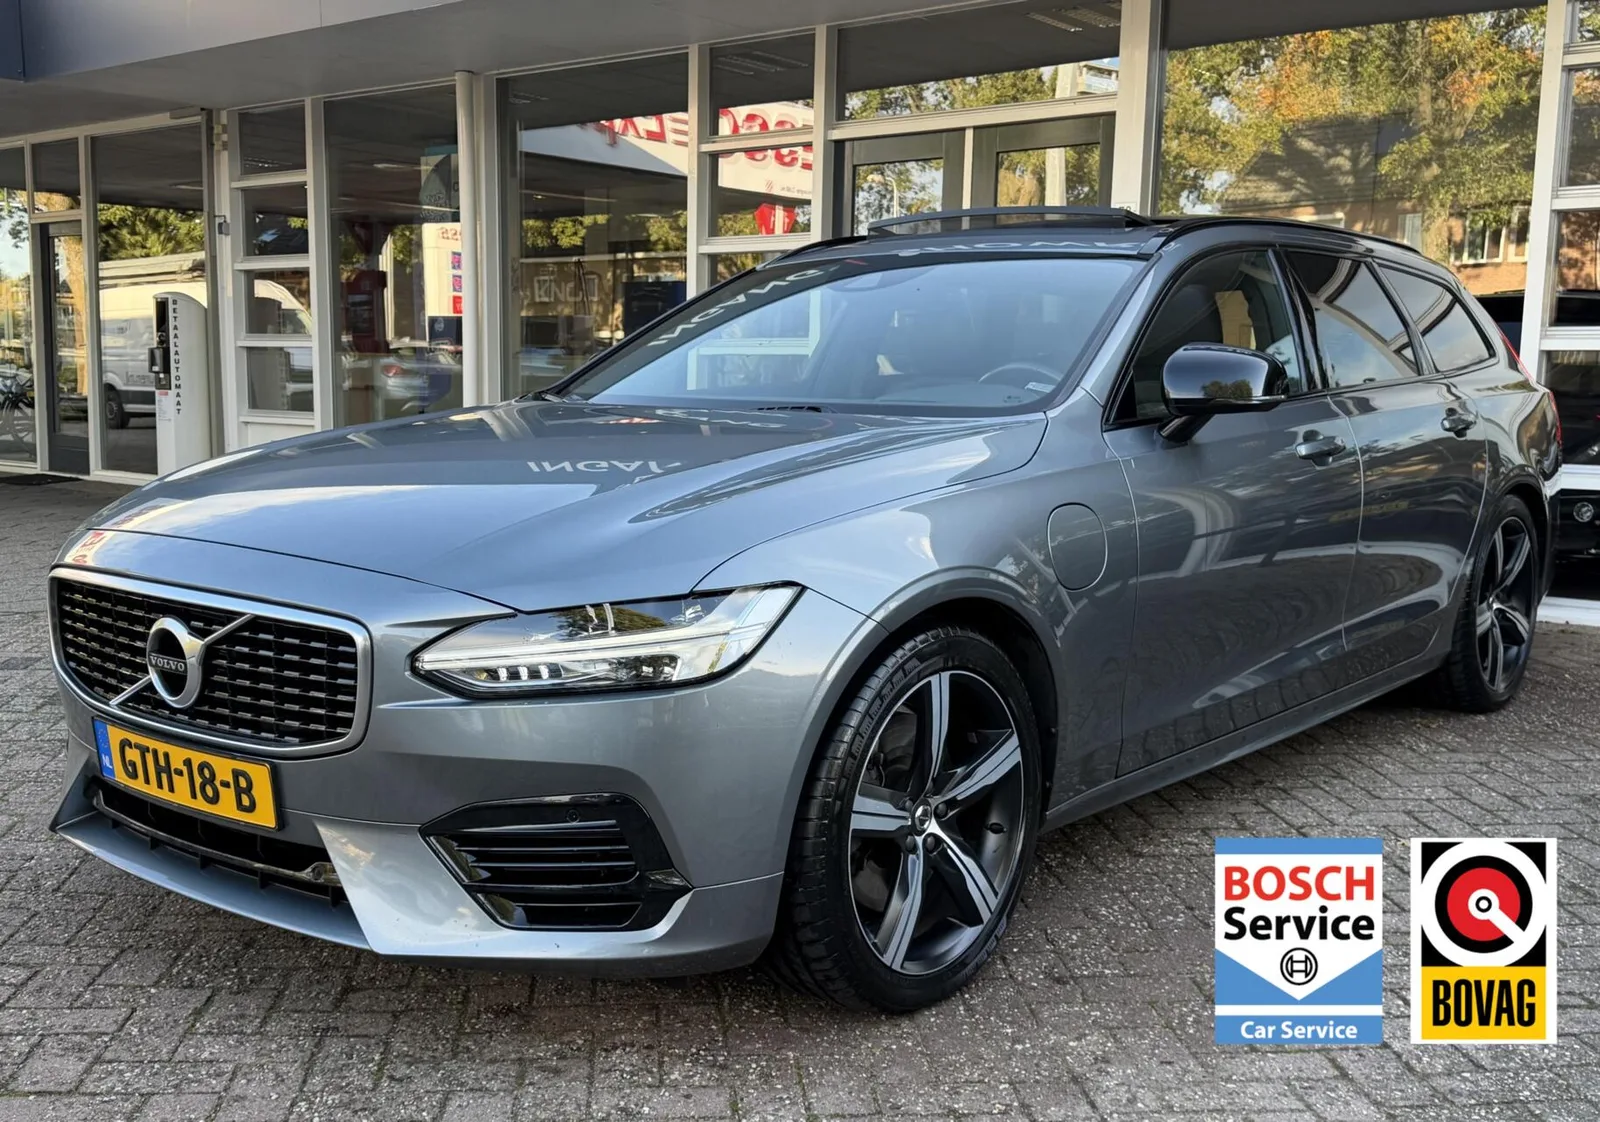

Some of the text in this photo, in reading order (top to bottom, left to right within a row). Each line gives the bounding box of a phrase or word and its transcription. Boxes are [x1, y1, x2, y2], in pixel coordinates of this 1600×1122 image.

[172, 299, 182, 415] BETAALAUTOMAAT
[150, 655, 185, 672] VOLVO
[102, 737, 257, 814] NL GTH-18-B
